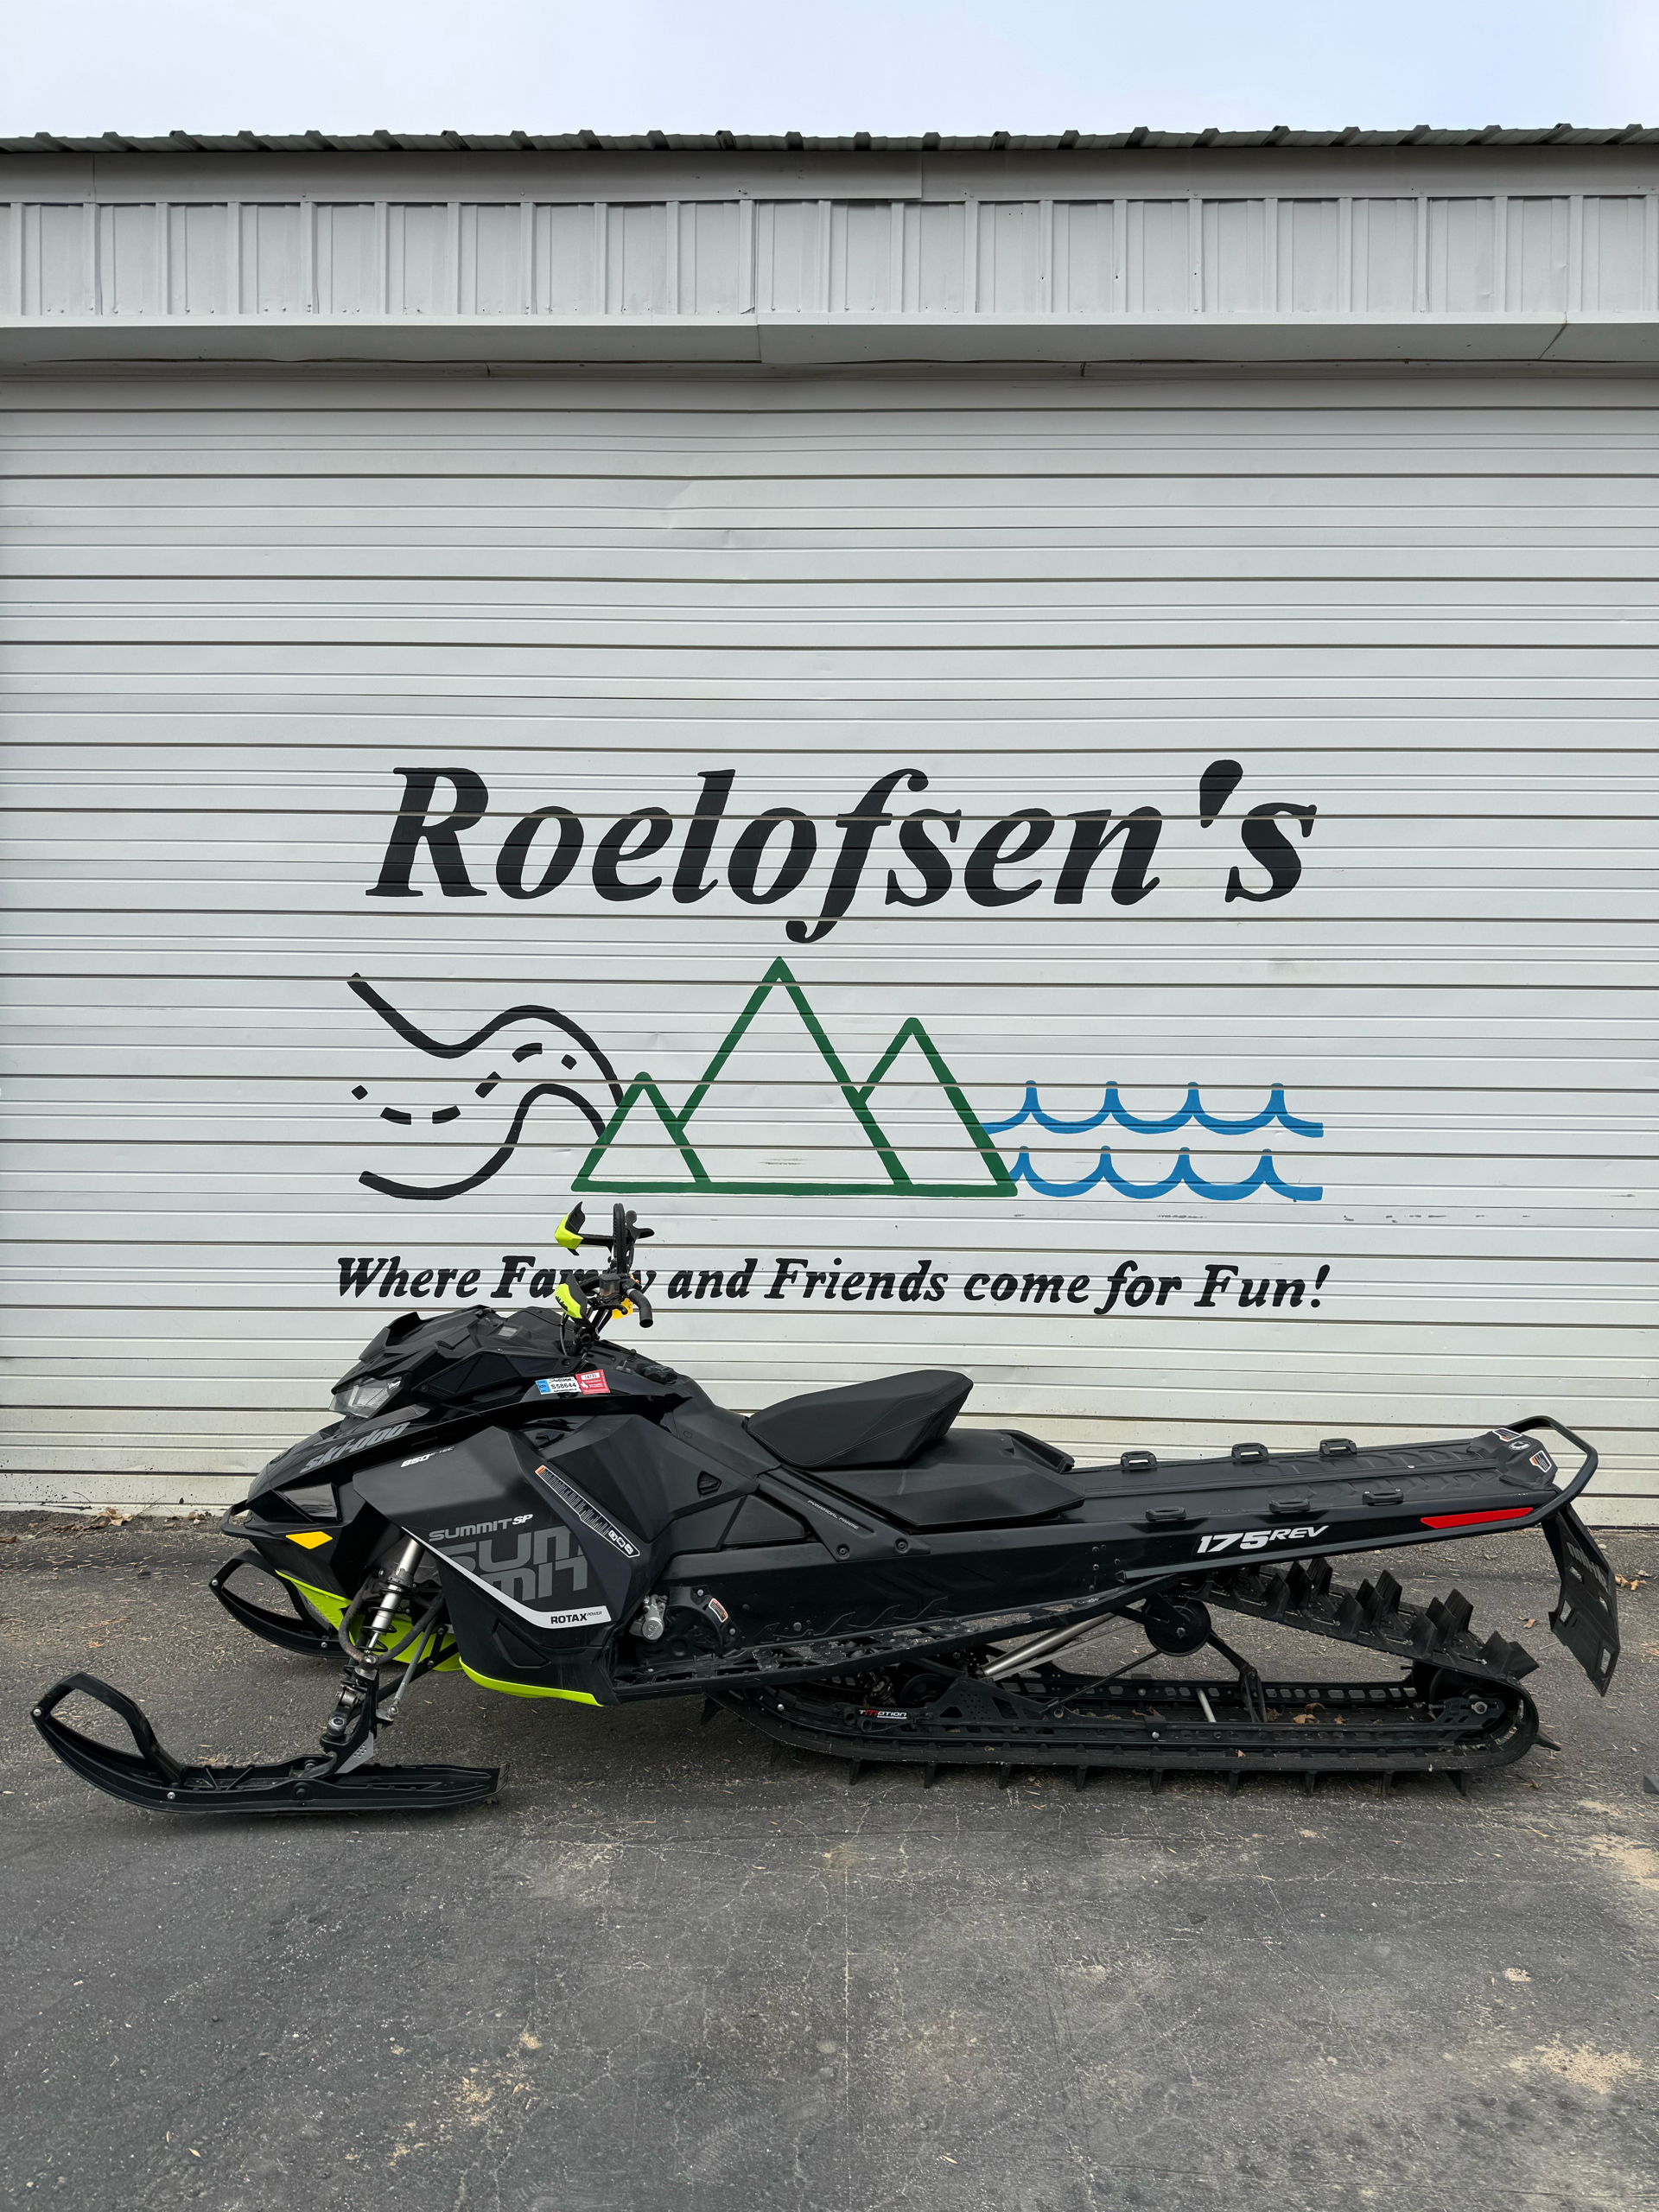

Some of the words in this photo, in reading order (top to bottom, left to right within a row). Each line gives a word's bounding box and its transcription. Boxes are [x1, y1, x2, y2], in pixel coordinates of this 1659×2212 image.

[365, 759, 1318, 944] Roelofsen's
[337, 1255, 479, 1300] Where
[491, 1255, 658, 1300] Fay
[667, 1258, 759, 1300] and
[764, 1256, 949, 1303] Friends
[963, 1273, 1090, 1304] come
[1093, 1260, 1183, 1315] for
[1193, 1264, 1332, 1309] Fun!
[429, 1517, 512, 1542] SUMMIT
[512, 1513, 533, 1525] SP
[1197, 1530, 1272, 1554] 175
[1268, 1525, 1329, 1541] REV
[550, 1612, 588, 1625] ROTAX
